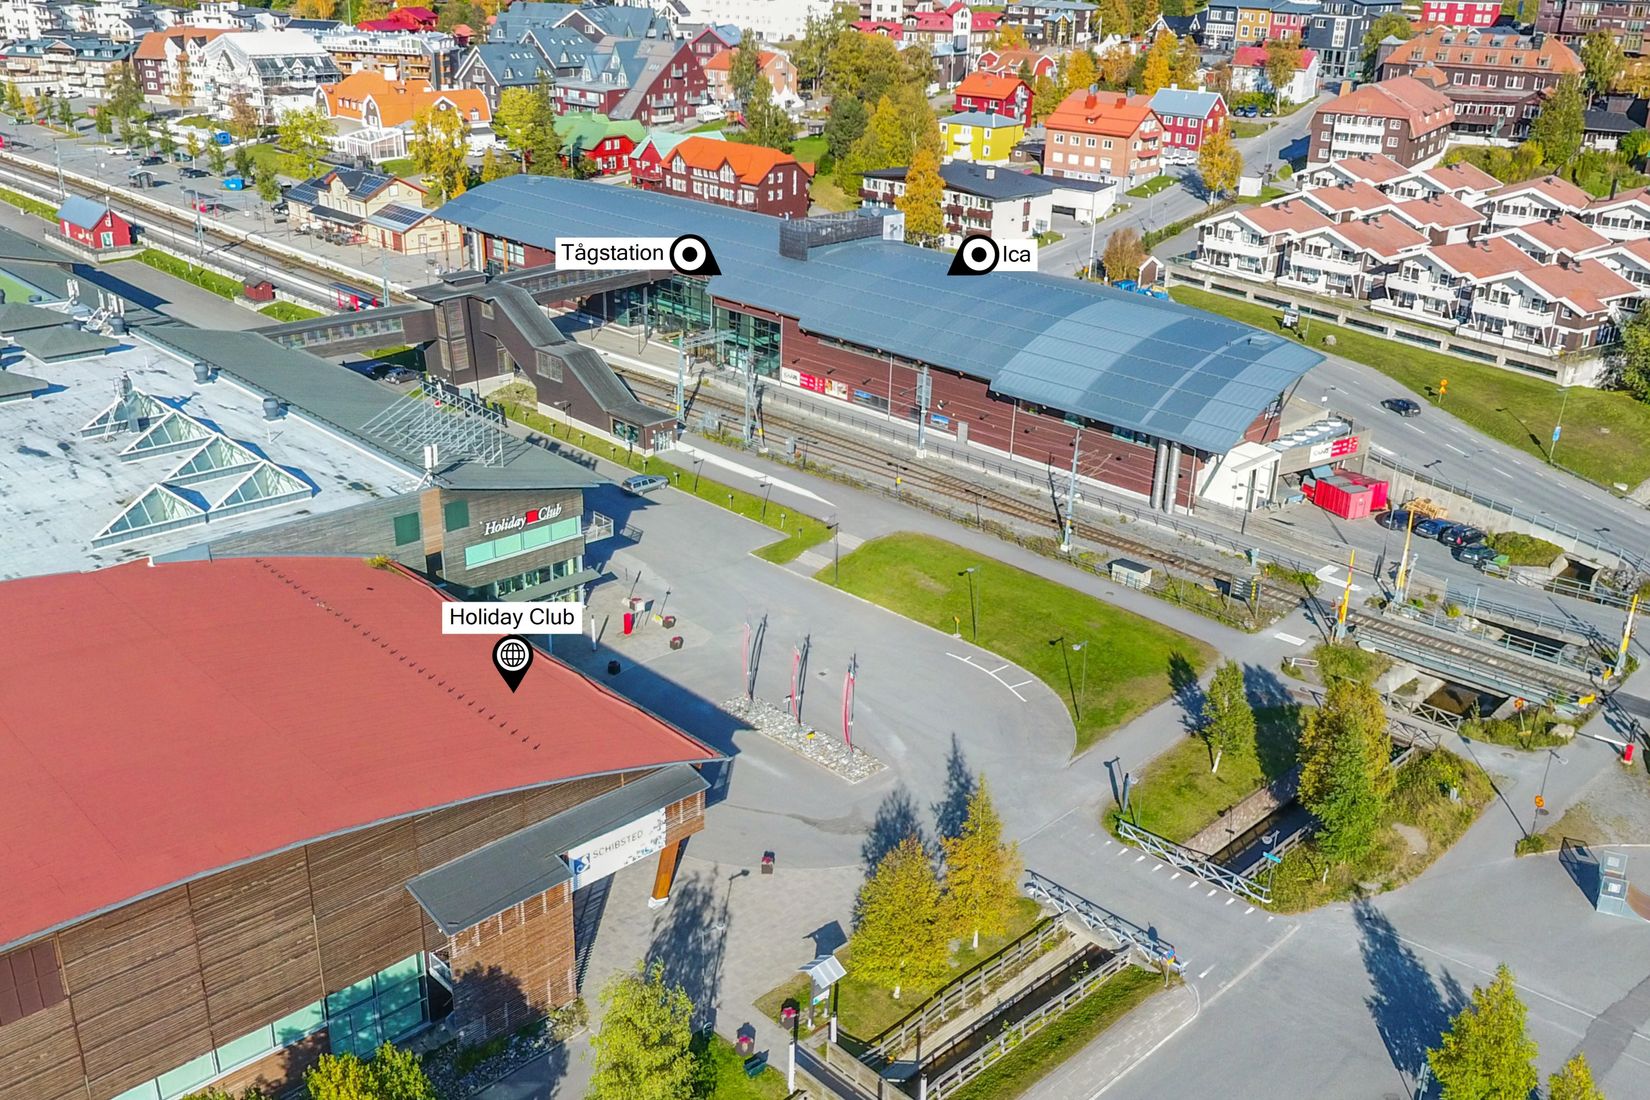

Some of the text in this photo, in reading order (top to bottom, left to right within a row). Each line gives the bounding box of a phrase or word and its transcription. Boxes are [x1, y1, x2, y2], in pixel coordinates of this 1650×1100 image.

[483, 503, 562, 536] Holiday Club
[592, 830, 644, 859] SCHIBSTED
